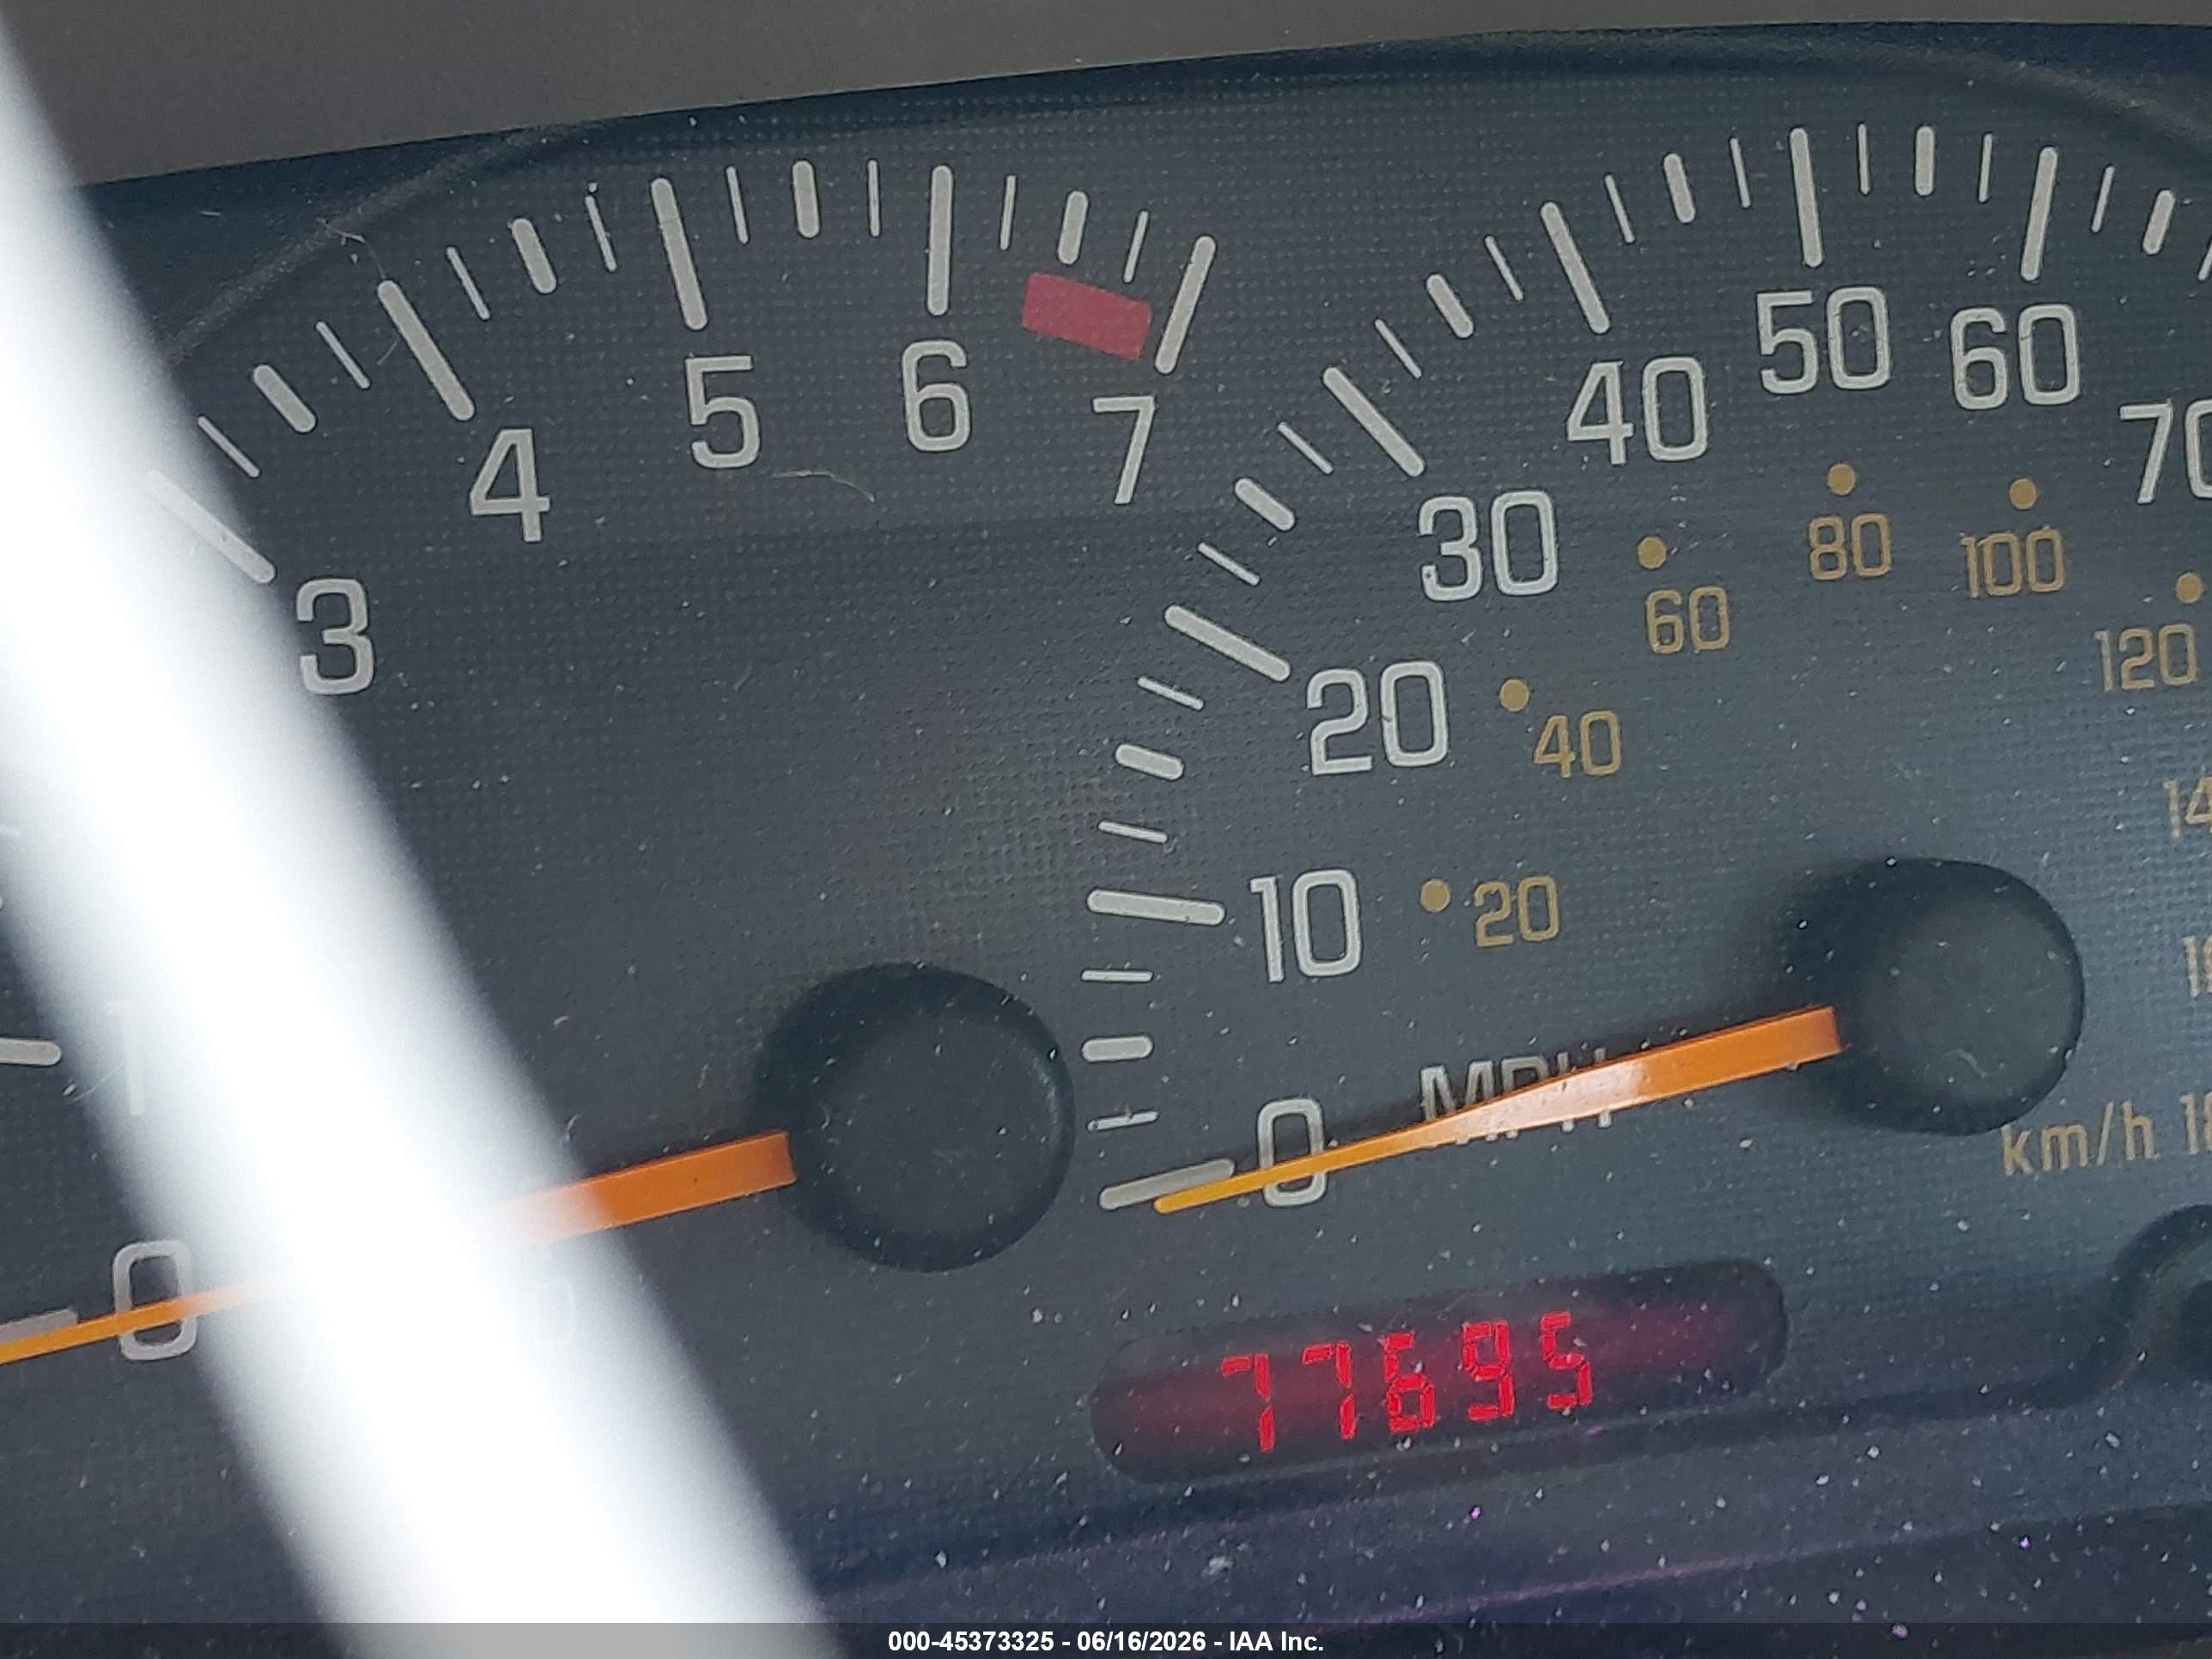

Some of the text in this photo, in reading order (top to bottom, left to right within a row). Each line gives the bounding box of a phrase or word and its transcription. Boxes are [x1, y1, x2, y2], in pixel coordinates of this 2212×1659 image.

[1758, 288, 1889, 393] 50
[1951, 305, 2079, 409] 60
[685, 356, 759, 467] 5
[902, 341, 969, 451] 6
[1093, 396, 1155, 503] 7
[1568, 357, 1707, 464] 40
[471, 429, 550, 541] 4
[1419, 491, 1557, 600] 30
[1808, 513, 1892, 581] 80
[1964, 527, 2066, 595] 100
[296, 578, 374, 695] 3
[1647, 586, 1729, 653] 60
[2094, 624, 2198, 690] 120
[1307, 661, 1448, 775] 20
[1534, 710, 1621, 776] 40
[1250, 870, 1360, 981] 10
[1474, 875, 1559, 947] 20
[1258, 1099, 1326, 1206] 0
[1999, 1099, 2157, 1178] km/h
[113, 1239, 198, 1362] 0
[1222, 1314, 1591, 1449] 77695
